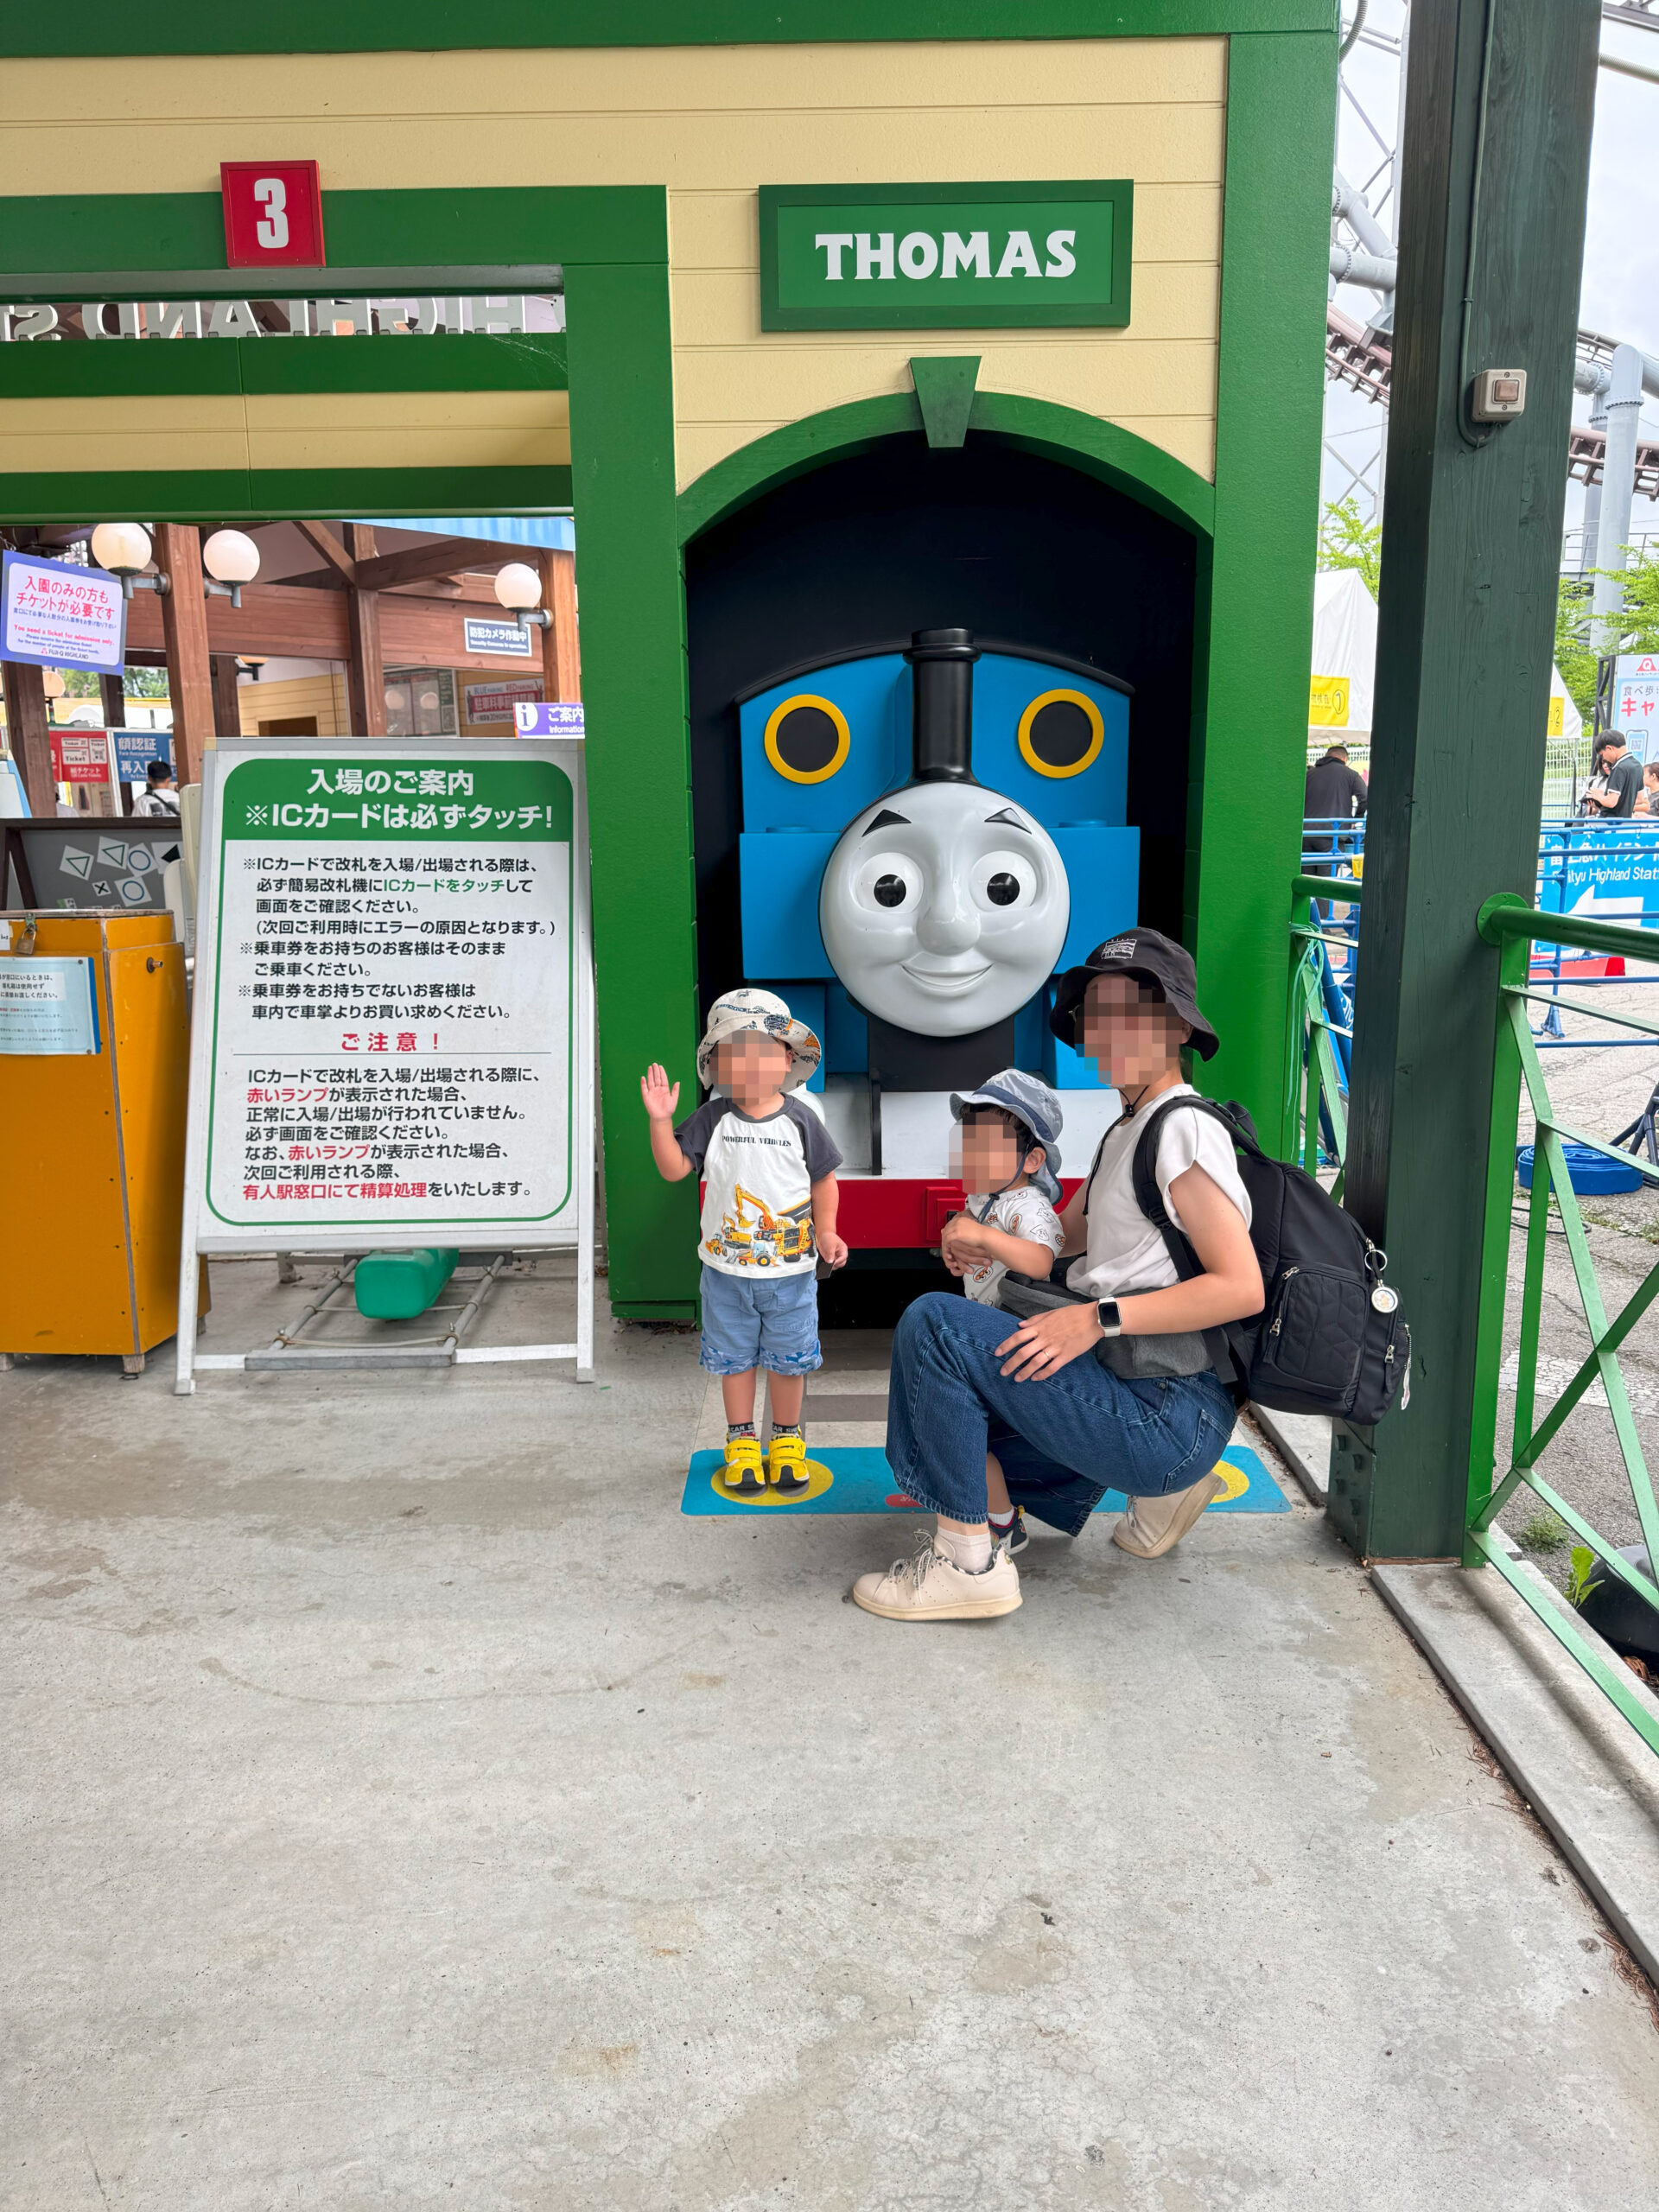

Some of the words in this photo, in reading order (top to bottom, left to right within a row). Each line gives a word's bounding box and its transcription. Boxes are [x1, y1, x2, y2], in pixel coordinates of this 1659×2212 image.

[253, 178, 289, 249] 3
[815, 230, 1077, 280] THOMAS
[25, 575, 109, 604] 入園のみの方も
[16, 592, 115, 620] チケットが必要です
[14, 624, 25, 632] You
[48, 629, 63, 638] ticket
[74, 634, 101, 644] admission
[1624, 685, 1659, 696] 食べ歩
[548, 706, 584, 722] ご案内
[118, 737, 157, 751] 顔認証
[121, 760, 151, 774] 再入
[307, 768, 474, 796] 入場のご案内
[1589, 868, 1630, 885] Highland
[1632, 866, 1659, 880] Stat
[256, 899, 418, 914] 画面をご確認ください。
[257, 919, 556, 936] (次回ご利用時にエラーの原因となります。)
[240, 940, 506, 956] ※乗車券をお持ちのお客様はそのまま
[254, 962, 371, 977] ご乗車ください。
[238, 982, 476, 999] ※乗車券をお持ちでないお客様は
[251, 1004, 510, 1020] 車内で車掌よりお買い求めください。
[248, 1066, 539, 1084] ICカードで改札を入場/出場される際に、
[247, 1086, 467, 1103] 赤いランプが表示された場合、
[245, 1104, 525, 1122] 正常に入場/出場が行われていません。
[245, 1124, 448, 1142] 必ず画面をご確認ください。
[721, 1135, 756, 1144] POWERFUL
[759, 1137, 791, 1147] VEHICLES
[245, 1142, 508, 1161] なお、赤いランプが表示された場合、
[244, 1163, 399, 1181] 次回ご利用される際、
[243, 1180, 531, 1201] 有人駅窓口にて精算処理をいたします。
